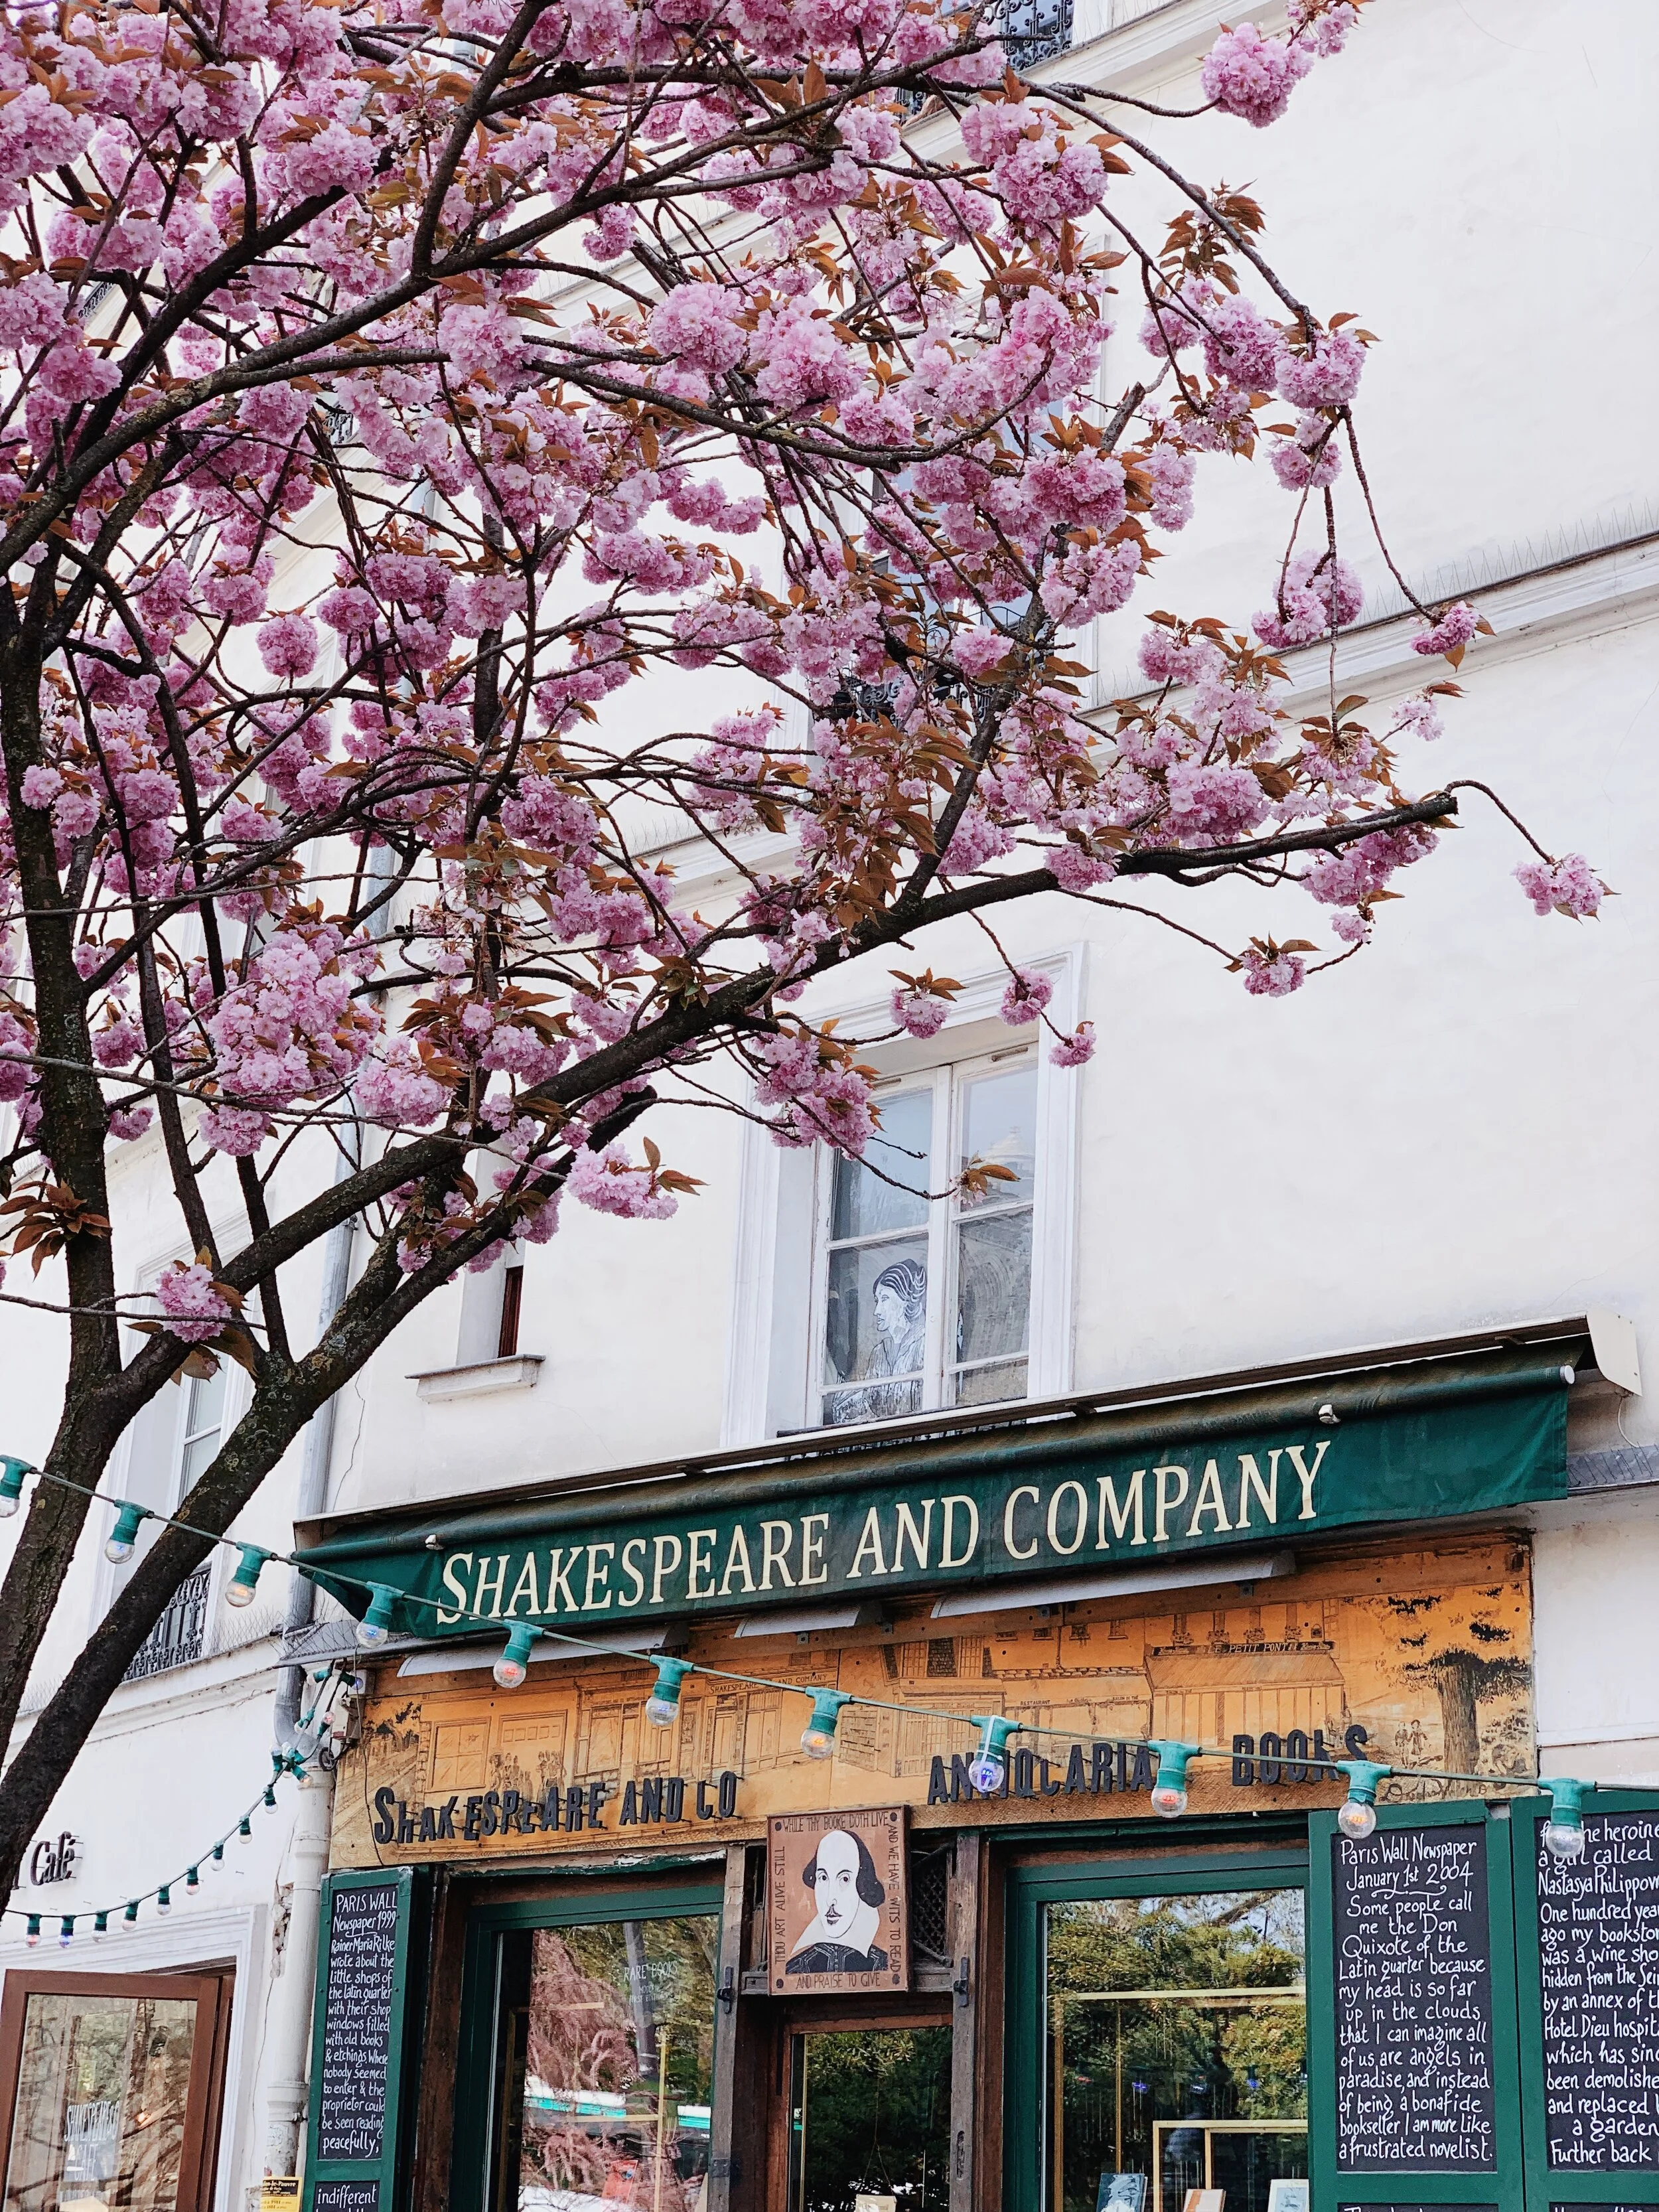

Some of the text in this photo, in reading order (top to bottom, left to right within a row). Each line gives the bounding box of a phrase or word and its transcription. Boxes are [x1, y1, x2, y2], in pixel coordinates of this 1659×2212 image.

[437, 1441, 1331, 1625] SHAKESPEARE AND COMPANY
[1229, 1643, 1259, 1653] PETIT
[1263, 1641, 1288, 1652] PONT
[710, 1681, 758, 1695] SHAKESPEARE
[796, 1673, 827, 1683] COMPANY
[1232, 1724, 1368, 1787] BOOKS
[619, 1777, 684, 1825] AND
[783, 1817, 804, 1832] WHILE
[807, 1816, 822, 1832] THY
[849, 1812, 869, 1828] DOTH
[871, 1811, 890, 1827] LIVE
[31, 1831, 76, 1885] Café
[1340, 1833, 1477, 1869] Paris Wall Newspaper
[1593, 1840, 1654, 1864] called
[1346, 1860, 1474, 1898] January 1st 2004
[1538, 1868, 1593, 1901] Nastasya
[336, 1891, 397, 1913] PARIS WALL
[774, 1846, 786, 1964] THOU ART ALIVE STILL
[888, 1824, 901, 1973] AND WE HAVE WITS TO READ
[1346, 1889, 1473, 1924] Some people call
[1540, 1897, 1632, 1924] One hundred
[332, 1910, 396, 1936] Newspaper 1999
[1359, 1913, 1457, 1935] me the Don
[330, 1934, 396, 1954] Rainer Maria Rilke
[1342, 1933, 1469, 1960] Quixote of the
[1540, 1927, 1593, 1951] ago my
[330, 1952, 395, 1968] wrote about the
[1339, 1953, 1486, 1983] Latin quarter because
[1542, 1945, 1628, 1966] was wine
[330, 1968, 393, 1988] little shops of
[624, 1964, 648, 1982] RARE
[796, 1972, 881, 1990] AND PRAISE TO GIVE
[1542, 1960, 1636, 1994] hidden from the
[328, 1984, 393, 2006] the latin quarter
[1339, 1974, 1477, 2008] my head is so far
[1581, 1993, 1624, 2010] annex
[328, 1999, 392, 2021] with their shop
[1346, 1999, 1480, 2029] up in the clouds
[326, 2015, 390, 2036] windows filled
[1339, 2021, 1487, 2051] that can imagine all
[1545, 2014, 1610, 2040] Hotel Dieu
[325, 2031, 383, 2047] with old books
[1546, 2039, 1625, 2065] which has
[325, 2046, 388, 2068] & etchings. Where
[1340, 2044, 1486, 2076] of us are angels in
[324, 2062, 387, 2083] nobody seemed
[1338, 2065, 1490, 2101] paradise, and instead
[1547, 2068, 1579, 2091] been
[333, 2079, 385, 2097] enter & the
[323, 2096, 386, 2118] proprietor could
[1338, 2092, 1354, 2118] of
[1357, 2093, 1394, 2121] being
[1548, 2093, 1573, 2114] and
[1578, 2091, 1650, 2120] replaced
[322, 2114, 384, 2140] be seen reading
[1340, 2112, 1492, 2137] bookseller more like
[1590, 2114, 1659, 2142] garden
[323, 2130, 379, 2158] peacefully,
[1350, 2134, 1493, 2166] frustrated novelist.
[1550, 2138, 1652, 2166] Further back
[317, 2184, 377, 2209] indifferent
